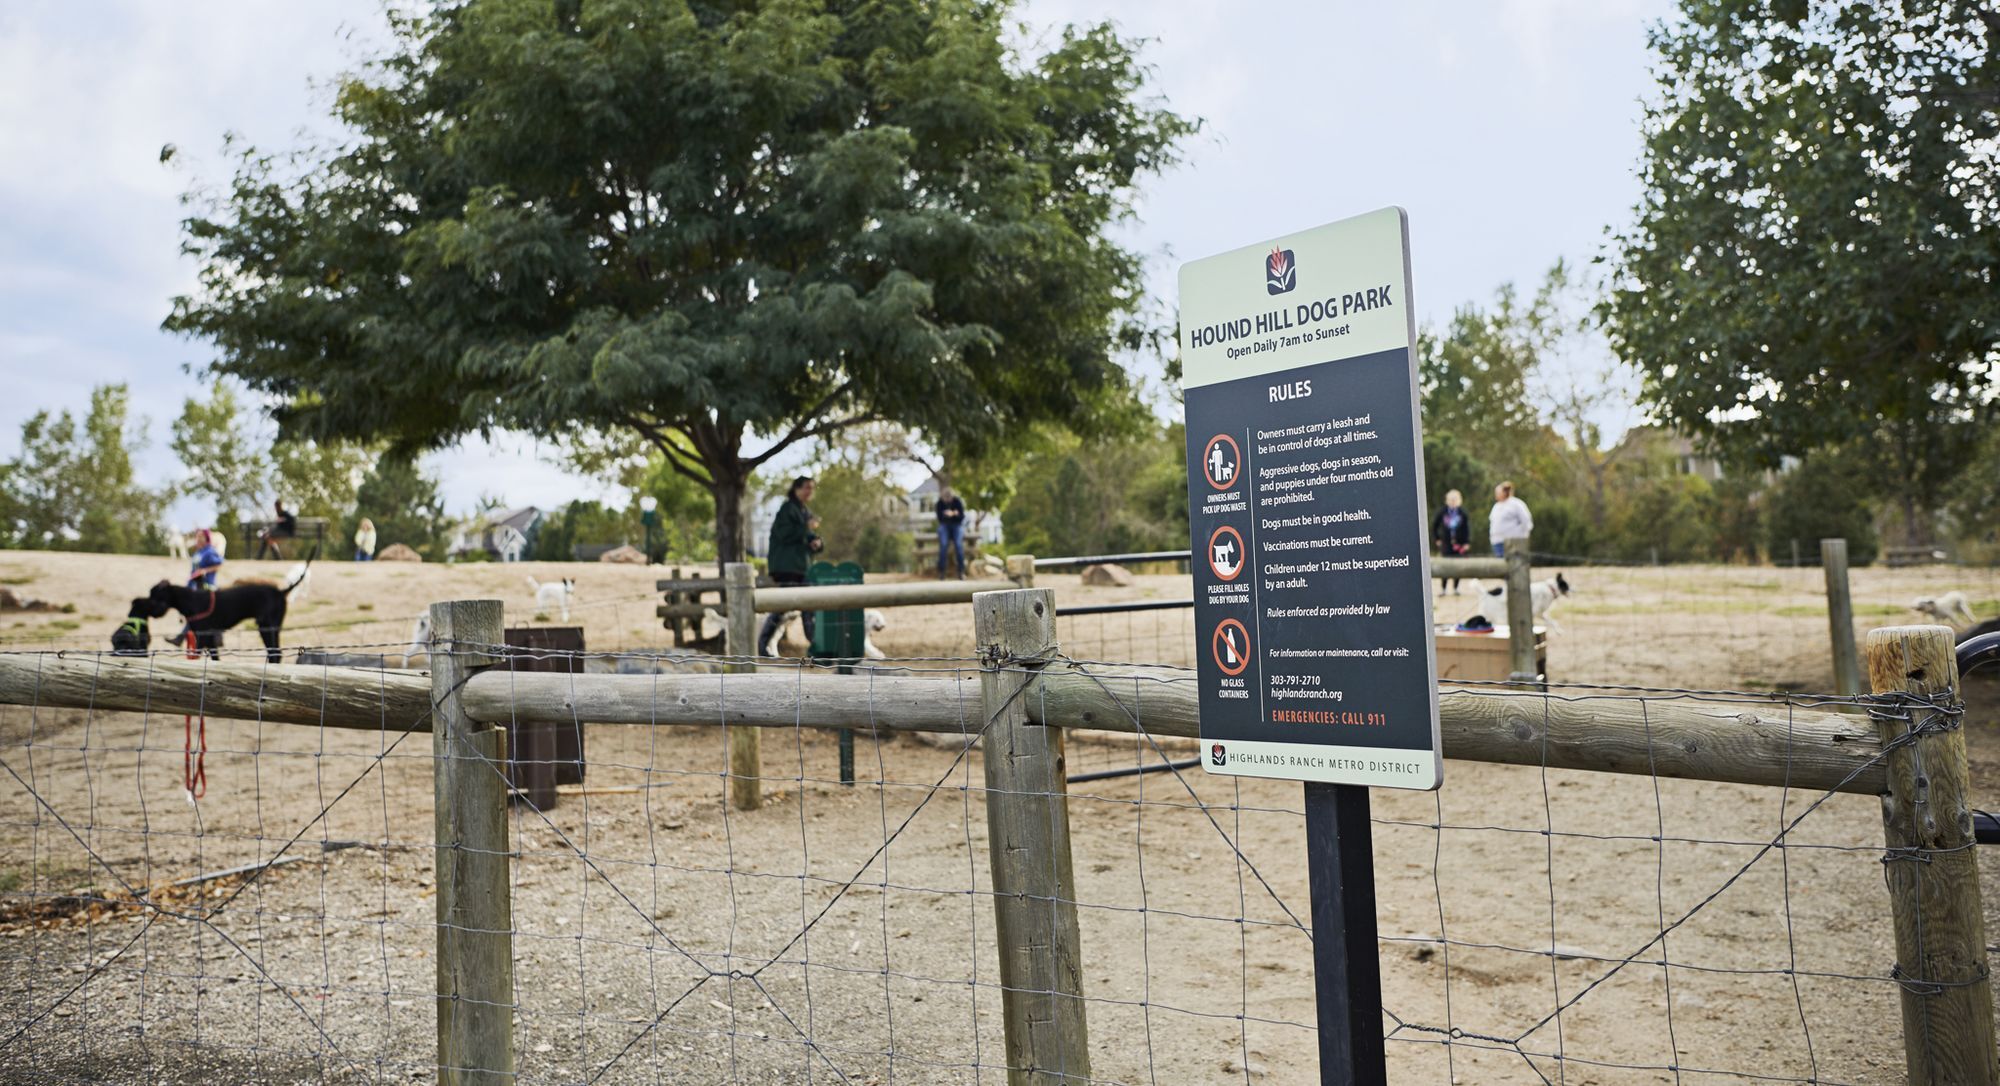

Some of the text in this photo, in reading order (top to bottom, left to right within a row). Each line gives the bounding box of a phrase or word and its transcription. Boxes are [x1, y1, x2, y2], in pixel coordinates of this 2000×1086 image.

[1191, 285, 1392, 349] HOUND HILL DOG PARK
[1227, 324, 1350, 360] Open Daily 7am to Sunset
[1269, 380, 1312, 402] RULES
[1257, 429, 1285, 440] Owners
[1286, 425, 1305, 435] must
[1306, 422, 1325, 433] carry
[1333, 417, 1353, 429] leash
[1354, 414, 1370, 426] and
[1259, 430, 1378, 454] be in control of dogs at all times.
[1260, 455, 1381, 479] Aggressive dogs, dogs in season,
[1260, 466, 1393, 492] and puppies under four months old
[1207, 492, 1240, 503] OWNERS MUST
[1261, 491, 1314, 507] are prohibited.
[1203, 506, 1214, 514] PICK
[1221, 504, 1230, 512] DOG
[1231, 502, 1246, 511] WASTE
[1262, 509, 1371, 530] Dogs must be in good health.
[1263, 535, 1373, 551] Vaccinations must be current.
[1265, 556, 1409, 575] Children under 12 must be supervised
[1208, 584, 1249, 594] PLEASE FILL HOLES
[1265, 578, 1308, 591] by an adult.
[1209, 596, 1219, 604] DUG
[1239, 595, 1249, 603] DOG
[1267, 608, 1286, 617] Rules
[1287, 606, 1318, 616] enforced
[1329, 605, 1363, 617] provided
[1365, 605, 1373, 615] by
[1375, 604, 1390, 614] law
[1269, 649, 1280, 657] For
[1281, 649, 1317, 658] information
[1326, 648, 1370, 657] maintenance,
[1371, 648, 1383, 656] call
[1393, 648, 1409, 657] visit:
[1221, 679, 1244, 687] NO GLASS
[1270, 676, 1320, 685] 303-791-2710
[1219, 690, 1248, 698] CONTAINERS
[1271, 688, 1342, 701] highlandsranch.org
[1272, 710, 1385, 726] EMERGENCIES: CALL 911
[1230, 753, 1420, 774] HIGHLANDS RANCH METRO DISTRICT
